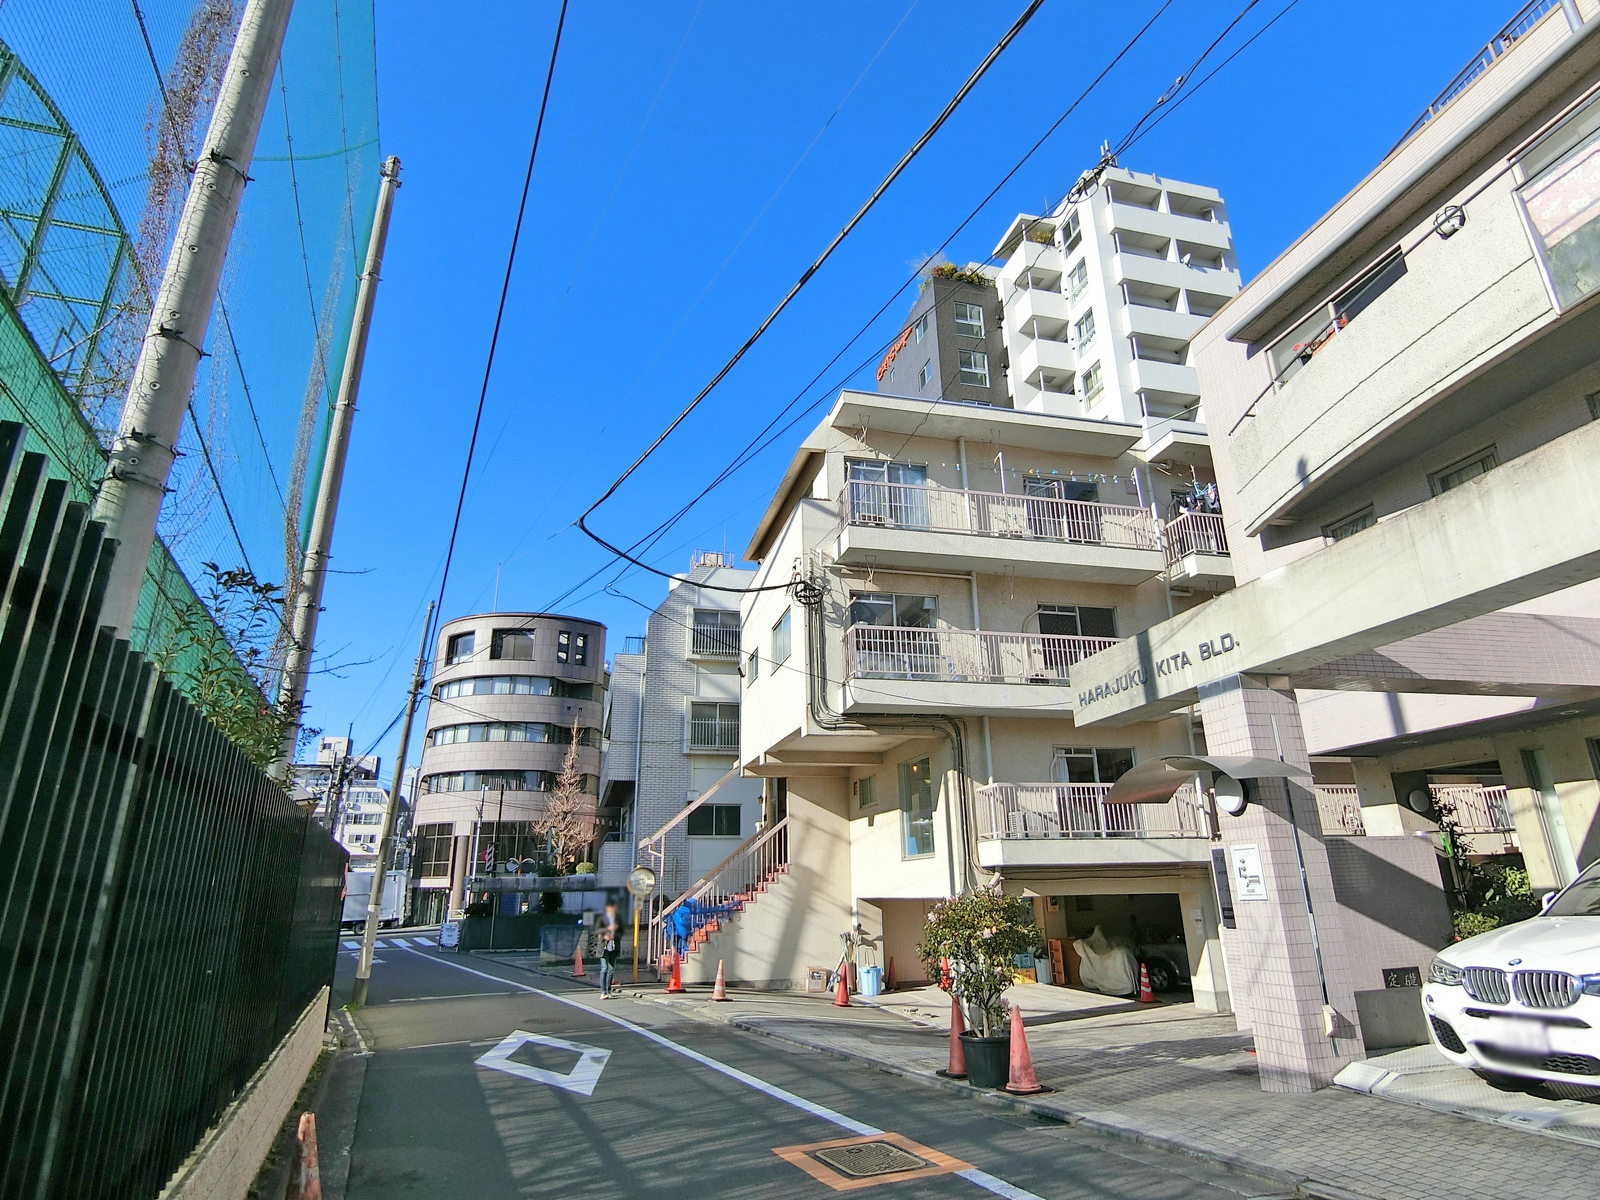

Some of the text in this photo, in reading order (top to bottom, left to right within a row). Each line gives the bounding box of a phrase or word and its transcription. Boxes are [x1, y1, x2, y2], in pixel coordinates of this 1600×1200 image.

[1078, 632, 1240, 707] HARAJUKU KITA BLD.
